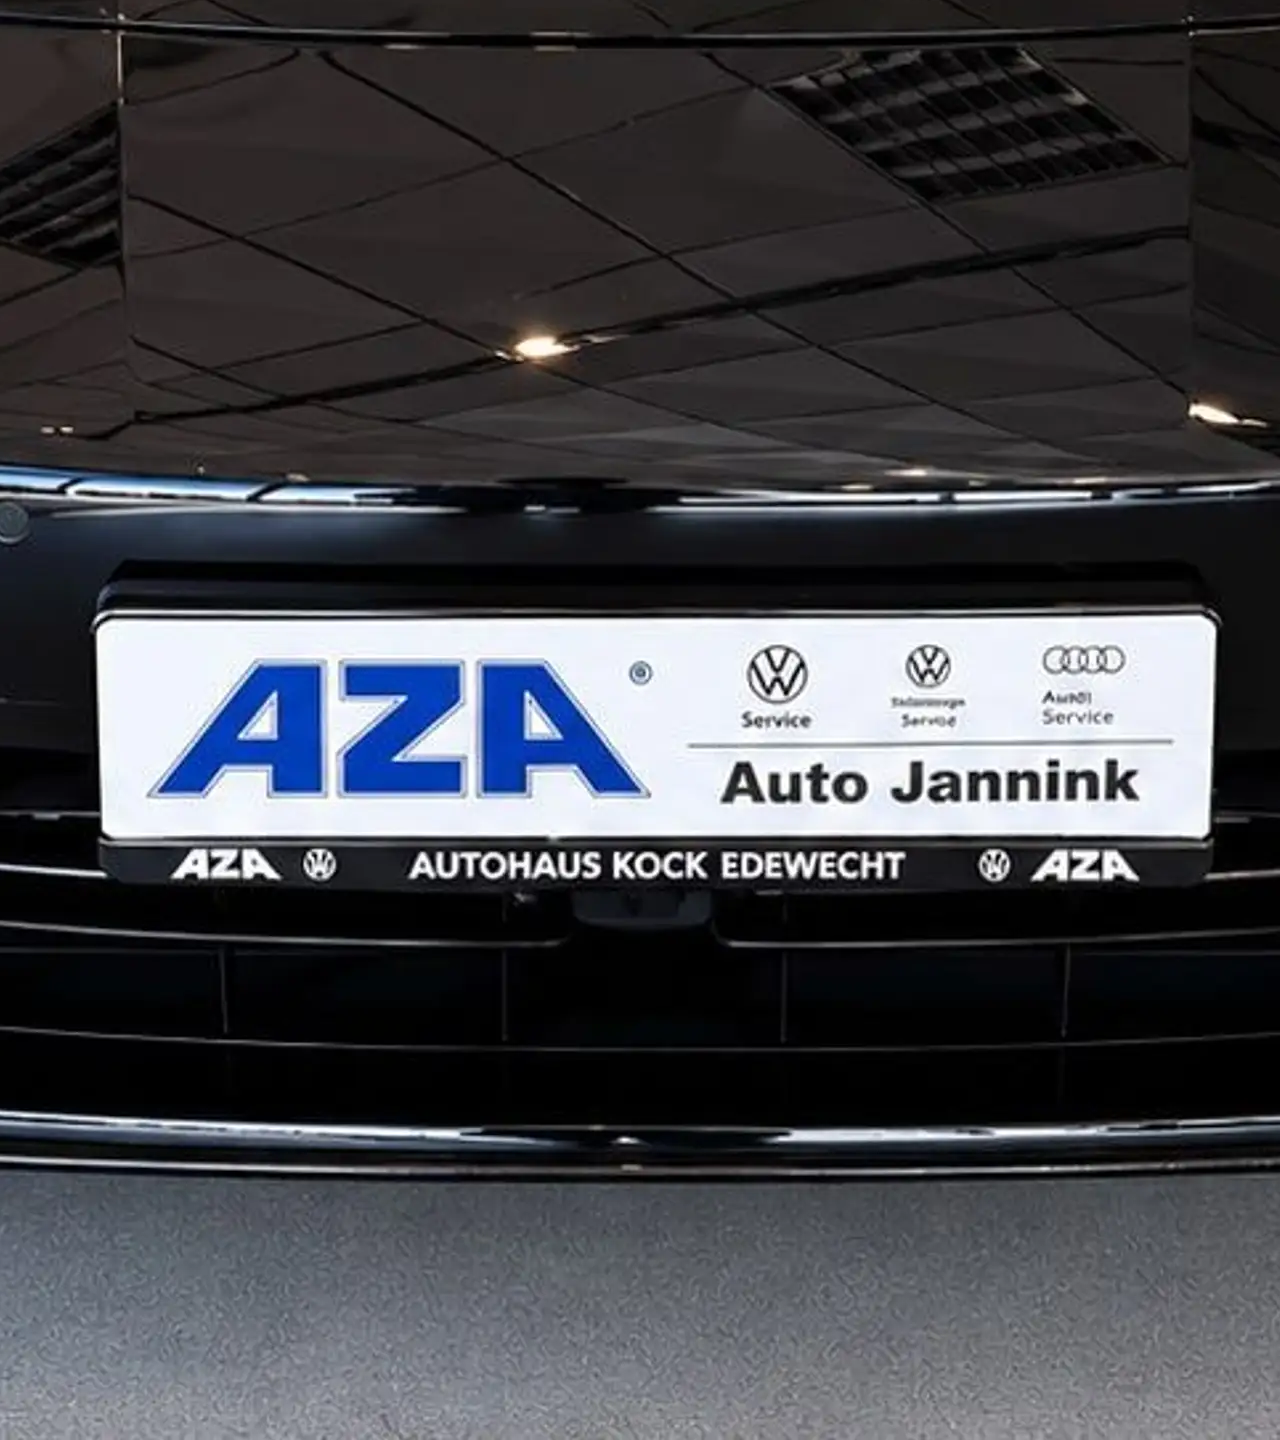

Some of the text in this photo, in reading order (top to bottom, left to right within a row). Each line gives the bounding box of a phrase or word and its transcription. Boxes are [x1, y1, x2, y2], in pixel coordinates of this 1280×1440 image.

[146, 659, 653, 799] AZA
[741, 711, 812, 729] Service
[1042, 709, 1115, 726] Service
[721, 759, 1140, 803] Auto Jannink
[170, 848, 281, 880] AZA
[409, 851, 602, 880] AUTOHAUS
[613, 851, 708, 879] KOCK
[721, 851, 907, 879] EDEWECHT
[1031, 849, 1140, 882] AZA
